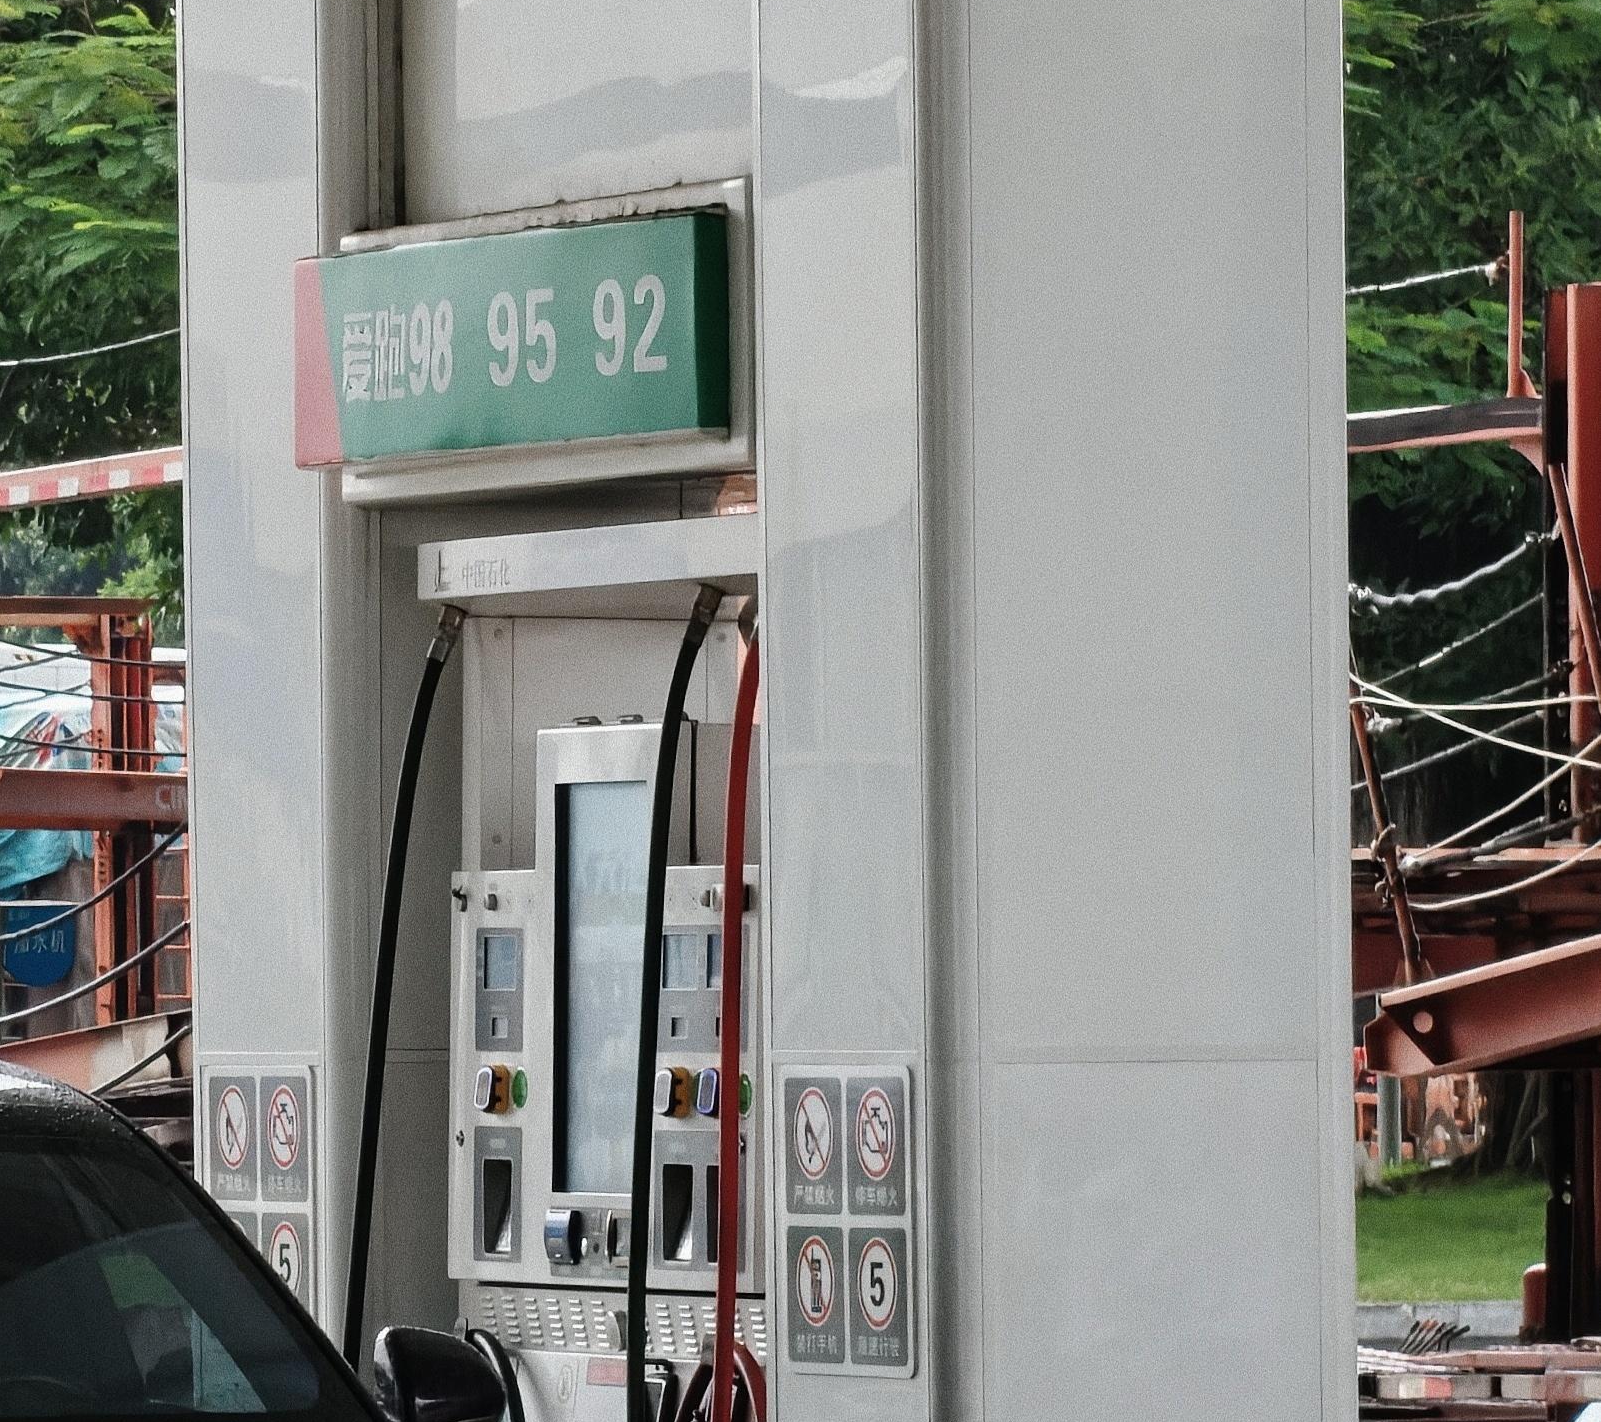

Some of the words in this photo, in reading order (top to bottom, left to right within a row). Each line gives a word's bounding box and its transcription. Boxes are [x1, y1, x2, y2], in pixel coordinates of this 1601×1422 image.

[486, 288, 557, 388] 95
[592, 274, 668, 377] 92
[278, 1244, 291, 1282] 5
[870, 1262, 885, 1307] 5
